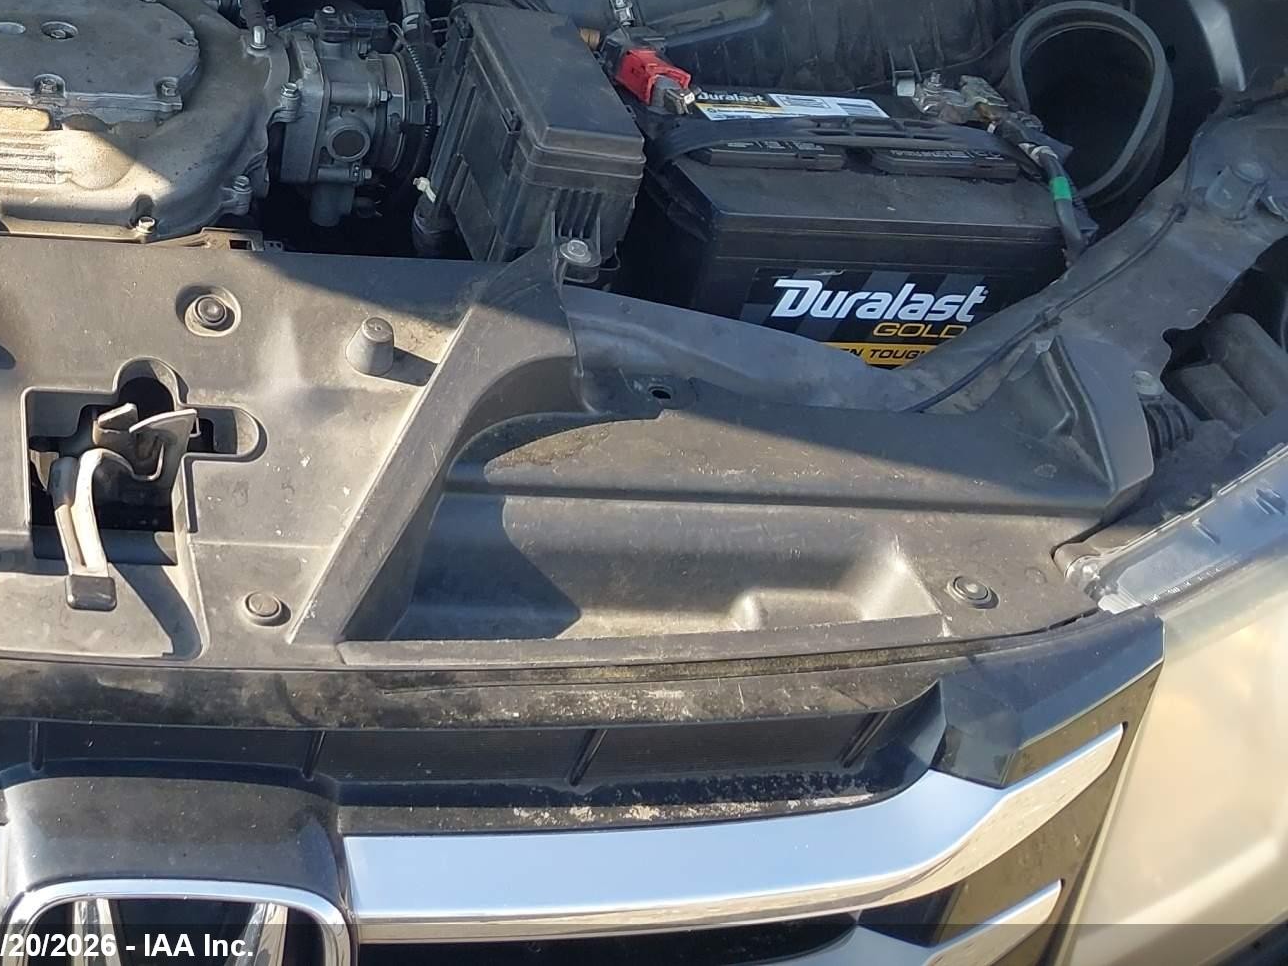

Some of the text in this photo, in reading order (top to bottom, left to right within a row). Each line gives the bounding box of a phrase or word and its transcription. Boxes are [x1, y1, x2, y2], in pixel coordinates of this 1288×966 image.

[698, 92, 764, 103] Duralast
[771, 278, 989, 323] Duralast
[873, 322, 967, 338] GOLD
[870, 349, 925, 359] TOUG
